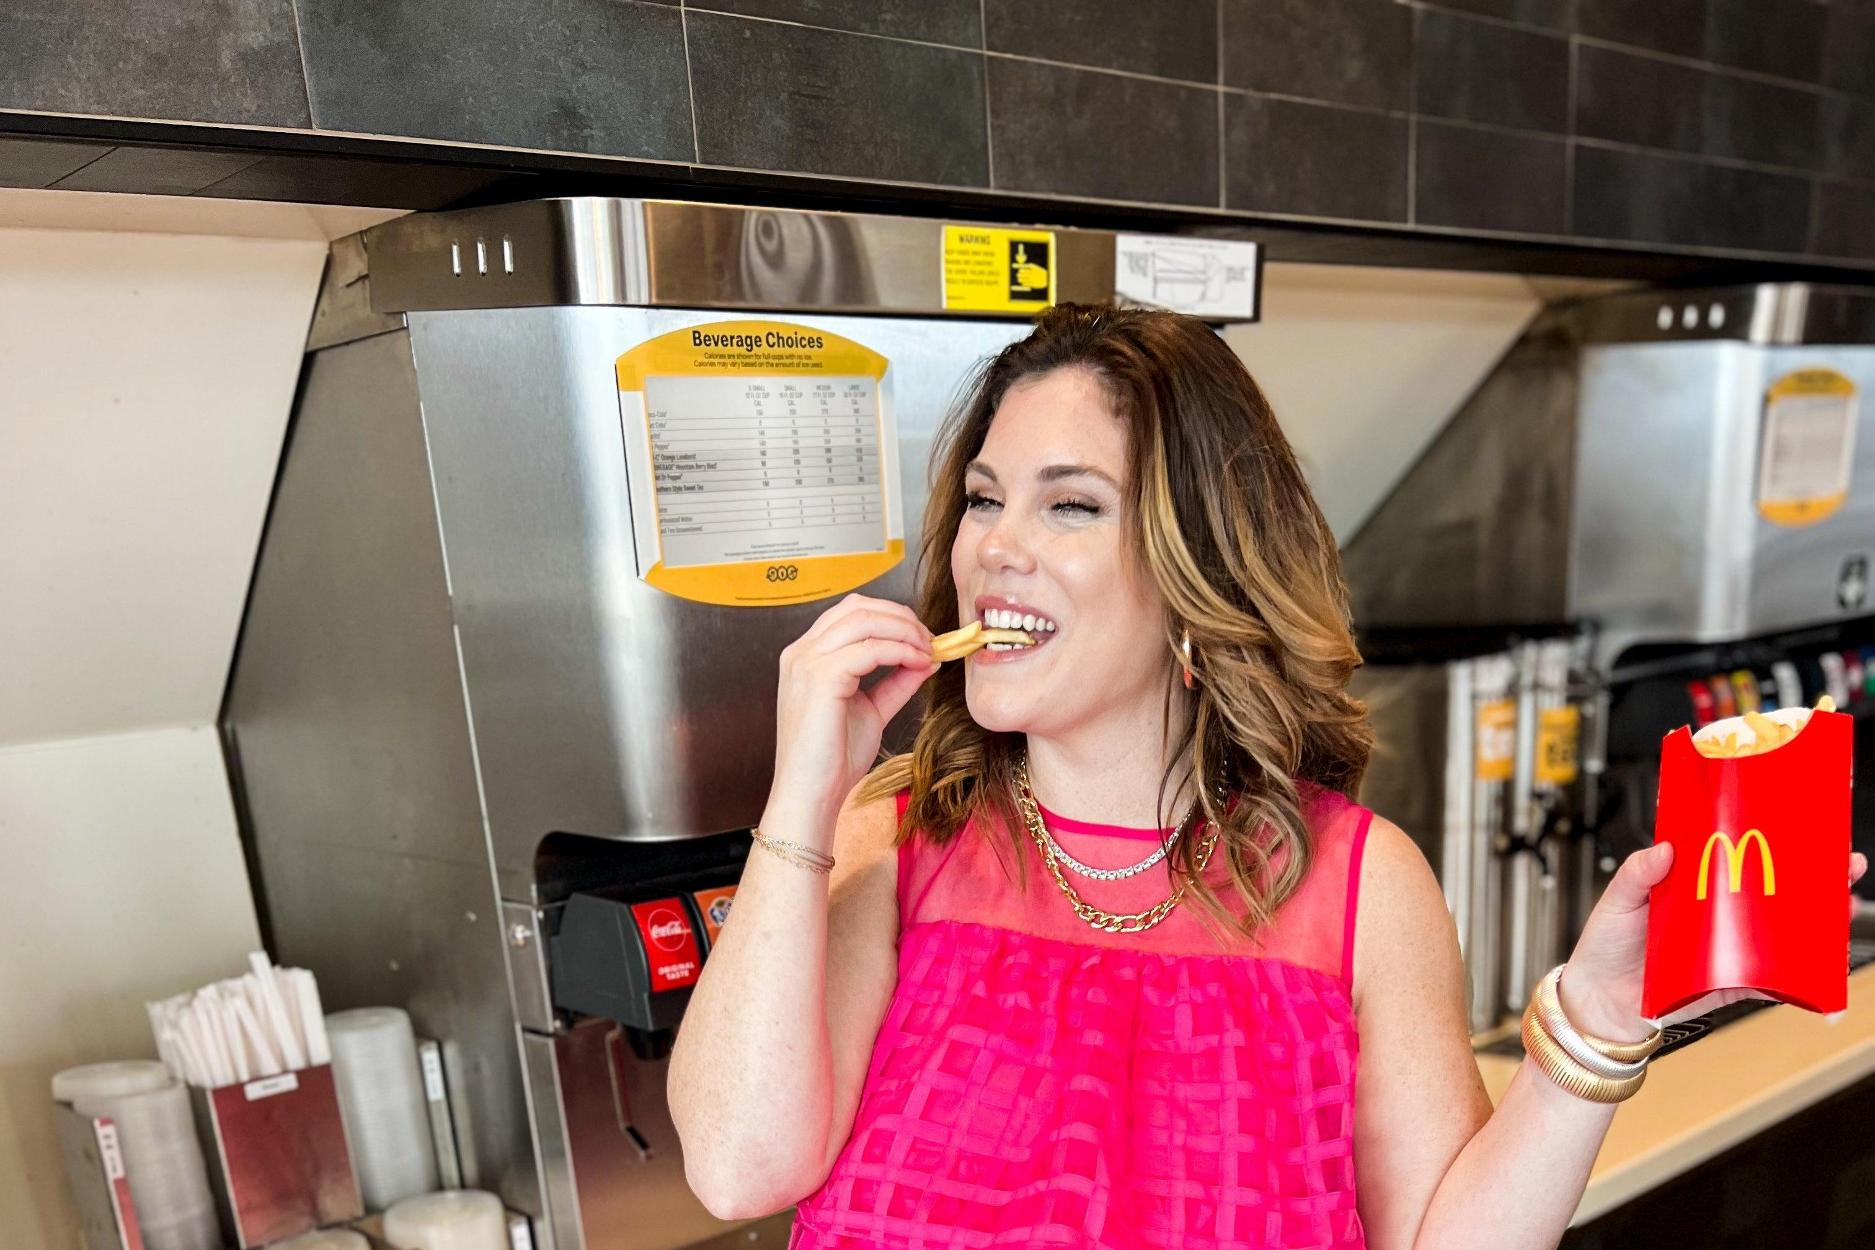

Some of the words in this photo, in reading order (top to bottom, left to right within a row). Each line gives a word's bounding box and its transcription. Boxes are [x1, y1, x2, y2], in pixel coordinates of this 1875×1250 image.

[692, 330, 762, 352] Beverage
[765, 331, 824, 349] Choices
[657, 962, 695, 976] ORIGINAL
[665, 969, 690, 981] TASTE
